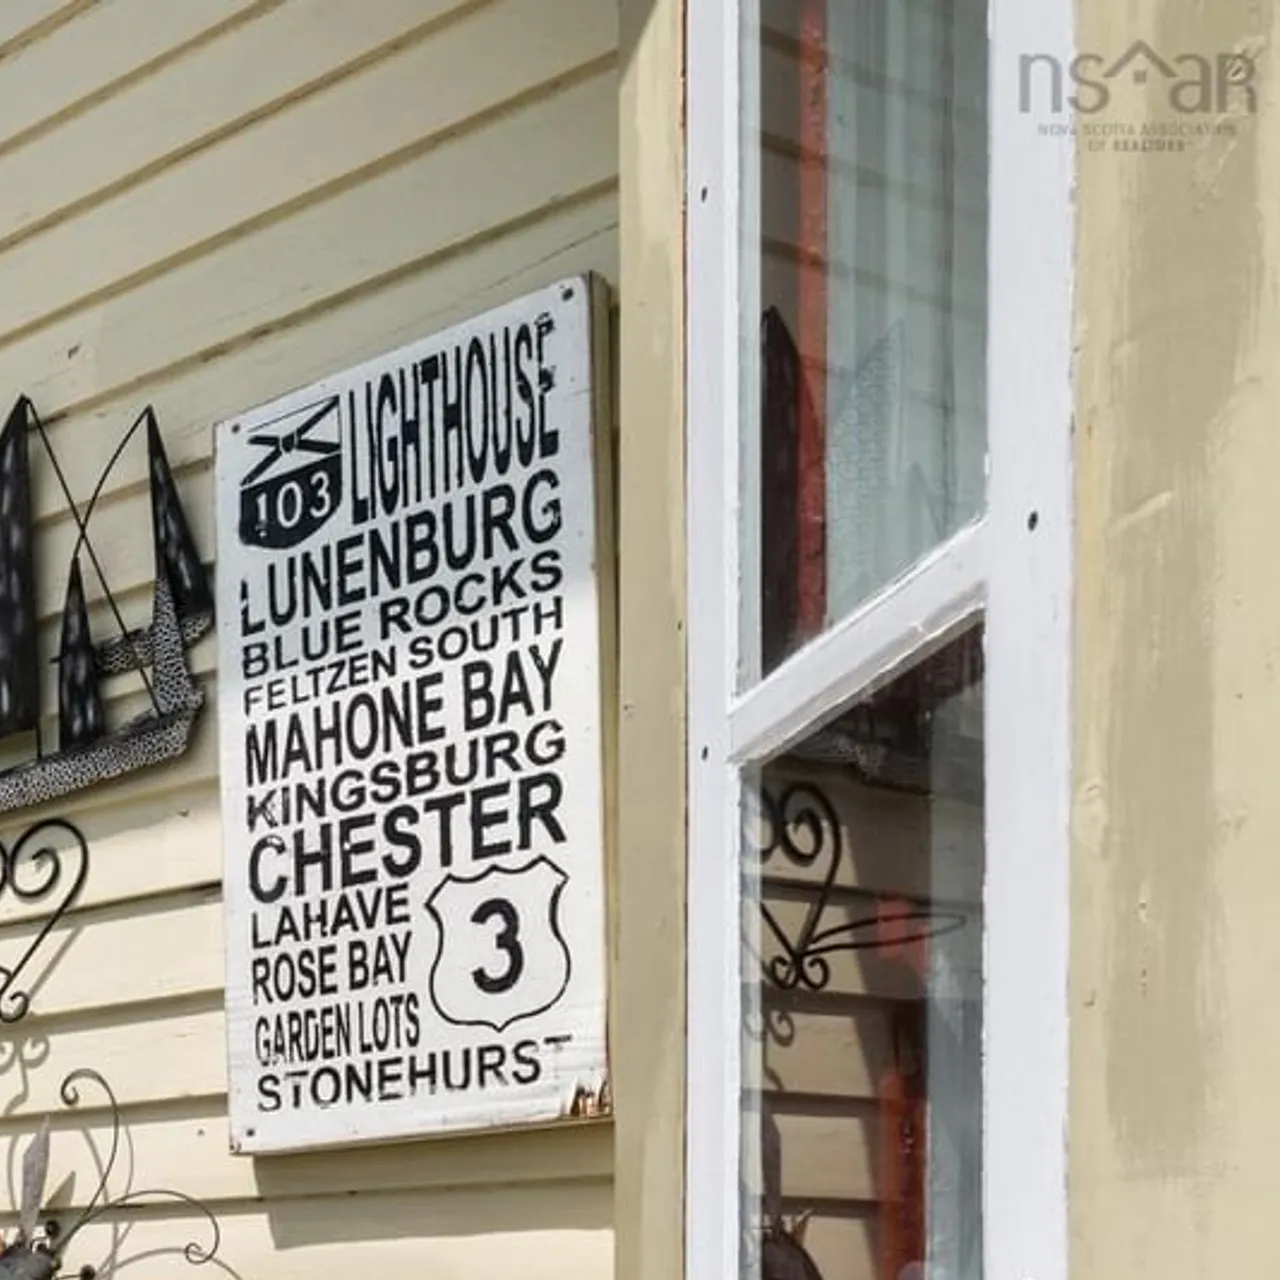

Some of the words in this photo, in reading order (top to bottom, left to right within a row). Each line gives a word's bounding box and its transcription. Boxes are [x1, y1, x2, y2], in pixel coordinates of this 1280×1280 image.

[348, 312, 559, 524] LIGHTHOUSE
[241, 468, 562, 637] LUNENBURG
[254, 470, 332, 539] 103
[242, 610, 363, 680] BLUE
[380, 550, 562, 640] ROCKS
[244, 646, 396, 717] FELTZEN
[408, 596, 562, 669] SOUTH
[245, 671, 446, 787] MAHONE
[462, 638, 562, 732] BAY
[247, 719, 566, 833] KINGSBURG
[248, 773, 567, 903] CHESTER
[251, 884, 411, 949] LAHAVE
[252, 943, 339, 1005] ROSE
[348, 932, 413, 990] BAY
[470, 897, 524, 994] 3
[255, 1004, 350, 1066] GARDEN
[358, 993, 420, 1059] LOTS
[257, 1034, 572, 1113] STONEHURST
